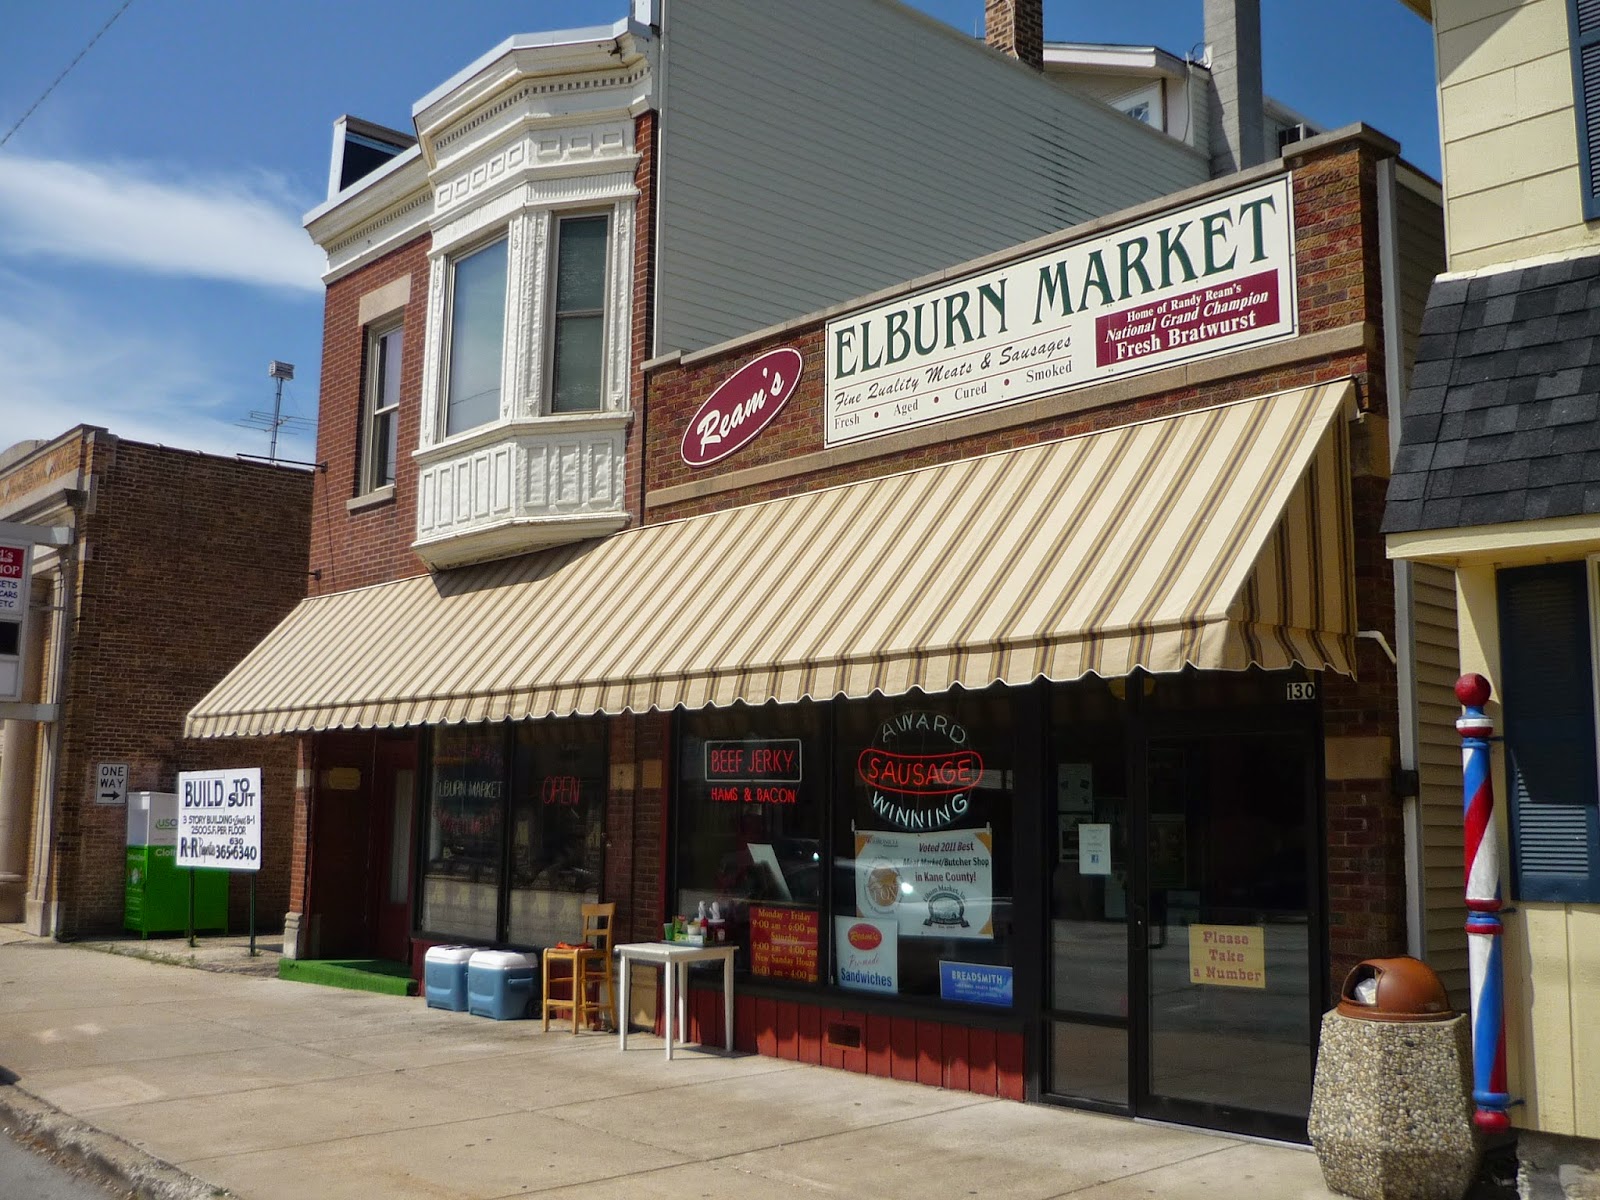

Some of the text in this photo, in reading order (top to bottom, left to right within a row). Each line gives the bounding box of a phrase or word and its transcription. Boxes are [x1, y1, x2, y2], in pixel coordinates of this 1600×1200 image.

[834, 194, 1277, 380] ELBURN MARKET
[1127, 283, 1242, 323] Home of Randy Ream's
[1105, 291, 1269, 343] National Grand Champion
[1116, 310, 1257, 361] Fresh Bratwurst
[834, 335, 1072, 412] Fine Quality Meats & Sausages
[834, 361, 1073, 430] Fresh Aged Cured Smoked
[696, 367, 785, 457] Ream's
[1287, 683, 1314, 699] 130
[882, 713, 966, 744] AWARD
[711, 749, 794, 773] BEEF JERKY
[101, 766, 124, 777] ONE
[868, 757, 972, 786] SAUSAGE
[100, 778, 124, 789] WAY
[233, 778, 250, 793] TO
[542, 775, 582, 806] OPEN
[185, 779, 224, 808] BUILD
[228, 792, 256, 808] SUIT
[711, 787, 796, 803] HAMS & BACON
[872, 790, 968, 828] WINNING
[183, 815, 188, 825] 3
[188, 815, 206, 825] STORY
[191, 826, 208, 835] 2500
[228, 826, 247, 836] FLOOR
[919, 841, 975, 853] Voted 2011 Best
[972, 856, 990, 868] Shop
[915, 871, 977, 884] in Kane County!
[758, 908, 811, 922] Monday Friday
[771, 931, 799, 944] Saturday
[1203, 930, 1249, 945] Please
[1208, 948, 1245, 963] Take
[841, 968, 893, 988] Sandwiches
[951, 970, 1003, 985] BREADSMITH
[1193, 966, 1262, 982] a Number
